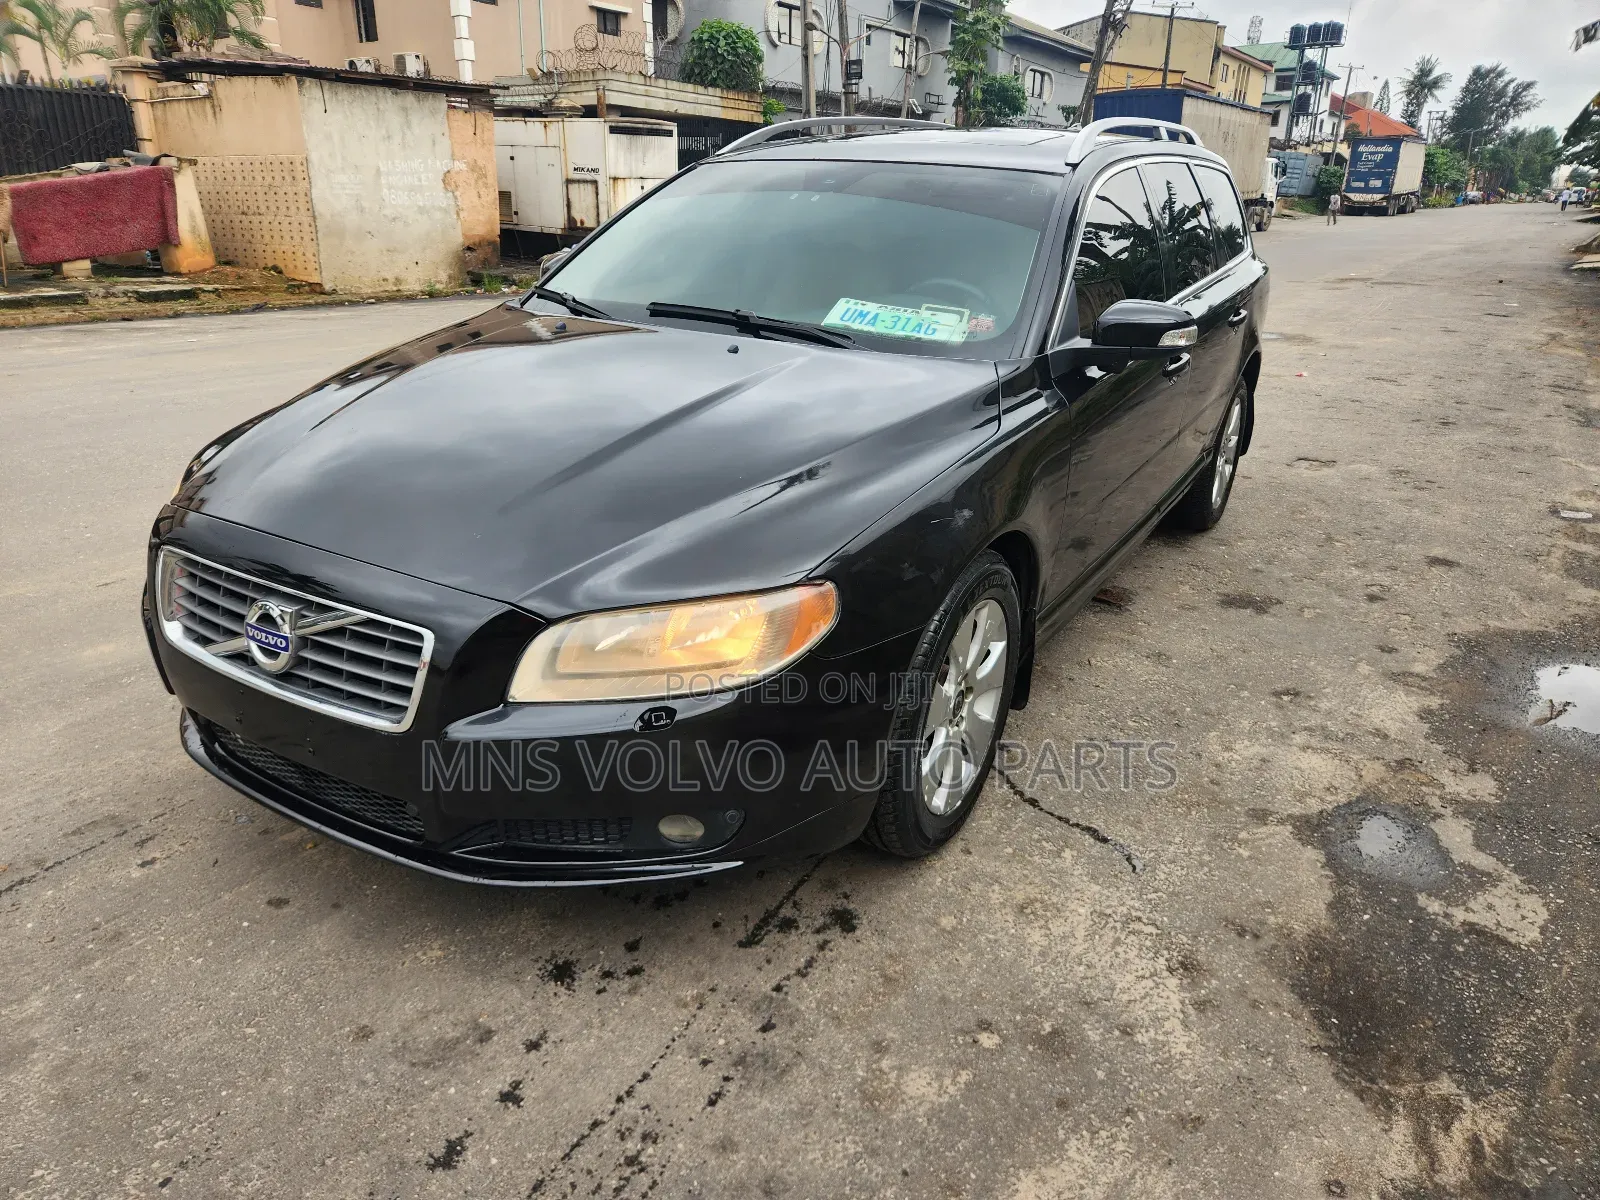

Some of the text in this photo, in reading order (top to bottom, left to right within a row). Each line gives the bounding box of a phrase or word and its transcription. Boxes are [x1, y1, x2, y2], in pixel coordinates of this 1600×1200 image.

[1358, 144, 1393, 152] Hollandia
[1361, 152, 1384, 162] Evap
[246, 626, 286, 648] VOLVO
